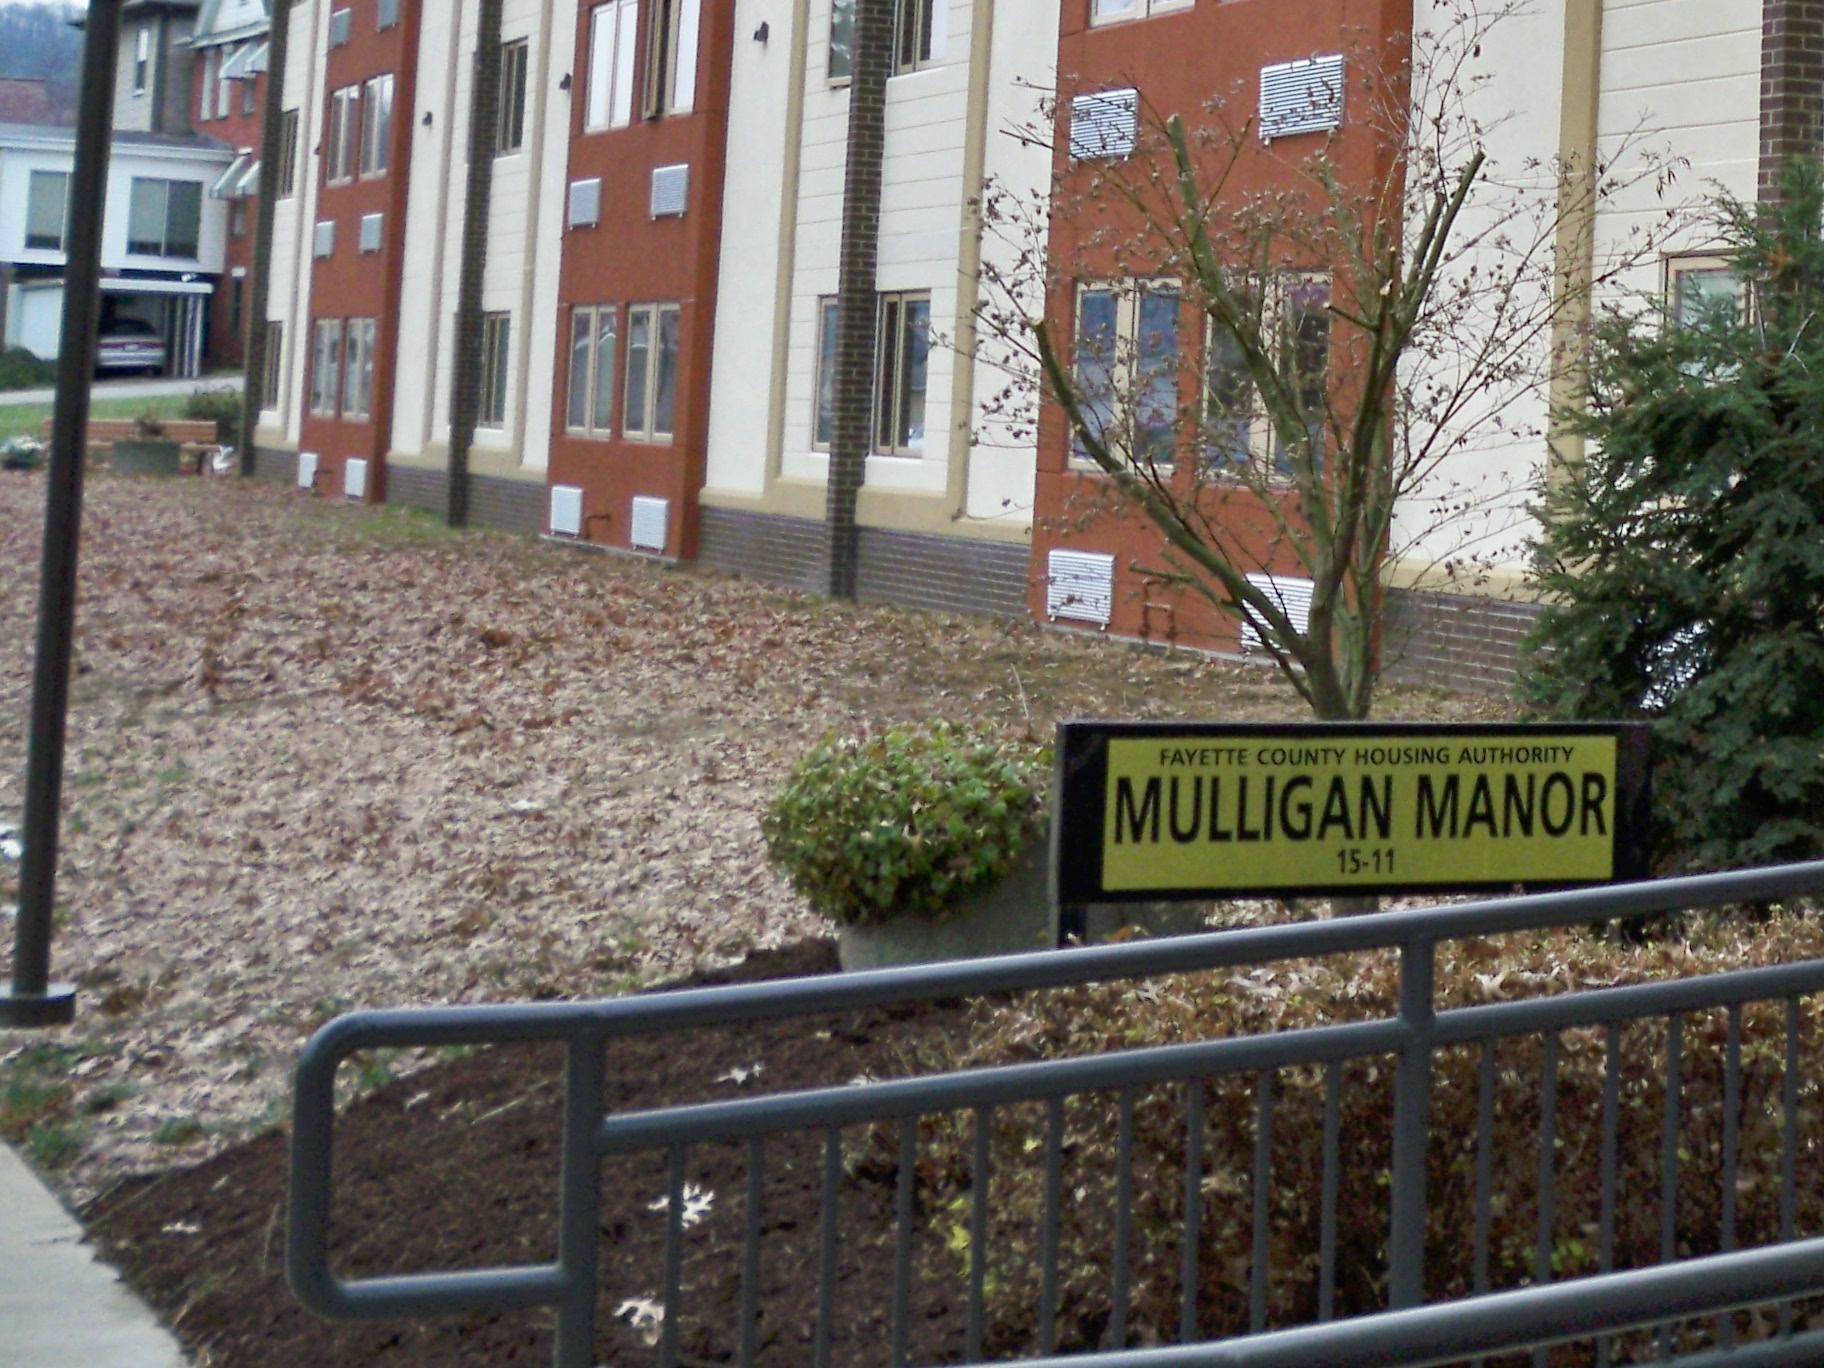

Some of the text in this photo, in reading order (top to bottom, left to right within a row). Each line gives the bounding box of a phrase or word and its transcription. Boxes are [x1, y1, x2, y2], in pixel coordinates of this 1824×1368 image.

[1159, 745, 1575, 767] FAYETTE COUNTY HOUSING AUTHORITY
[1113, 771, 1608, 845] MULLIGAN MANOR
[1337, 848, 1395, 874] 15-11
